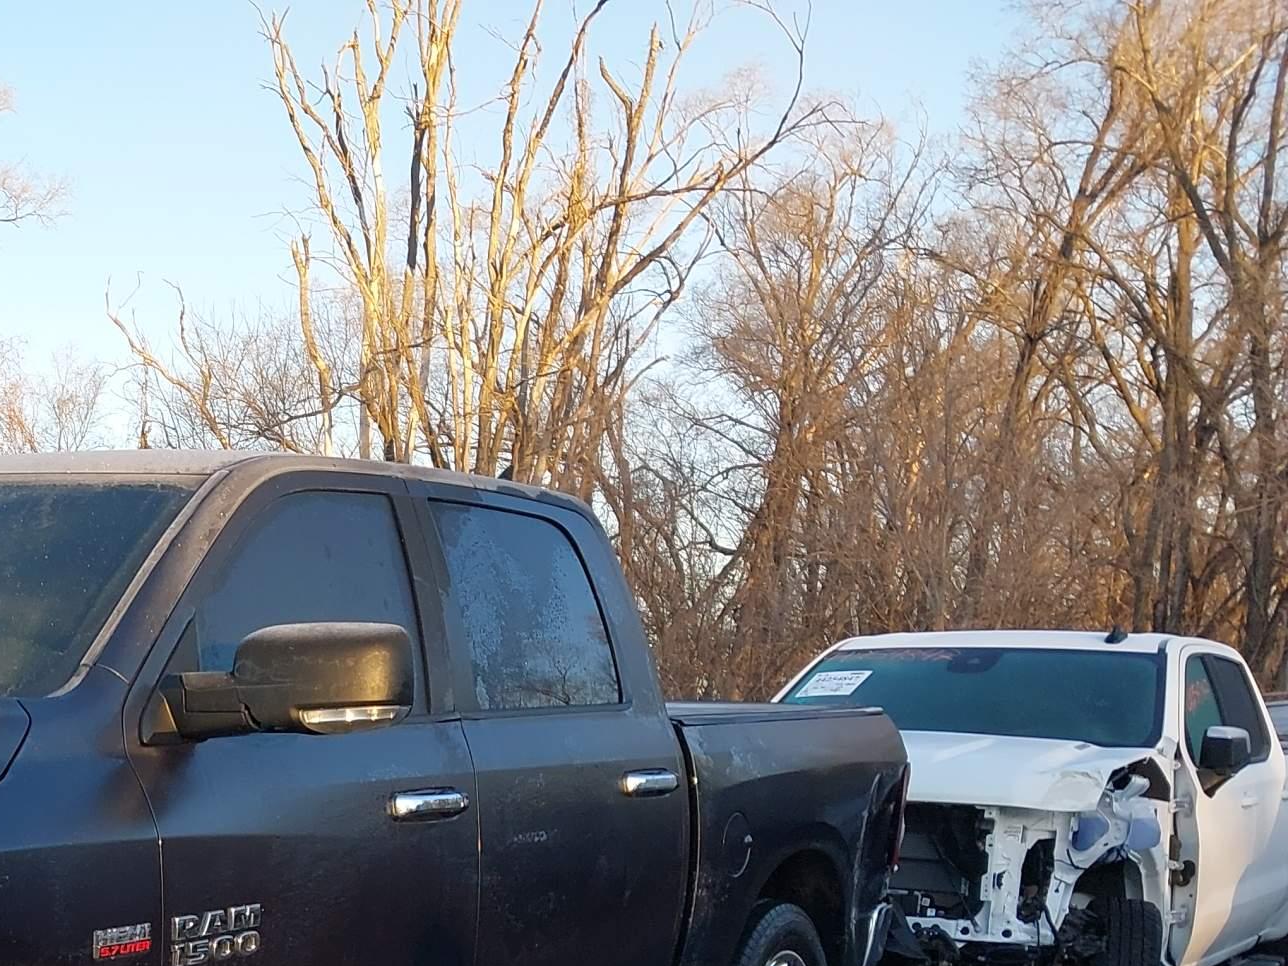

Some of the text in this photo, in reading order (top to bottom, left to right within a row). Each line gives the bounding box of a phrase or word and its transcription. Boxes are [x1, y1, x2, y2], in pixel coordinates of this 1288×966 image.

[94, 922, 152, 946] HEMI
[171, 903, 261, 941] RAM
[120, 940, 152, 954] LITER
